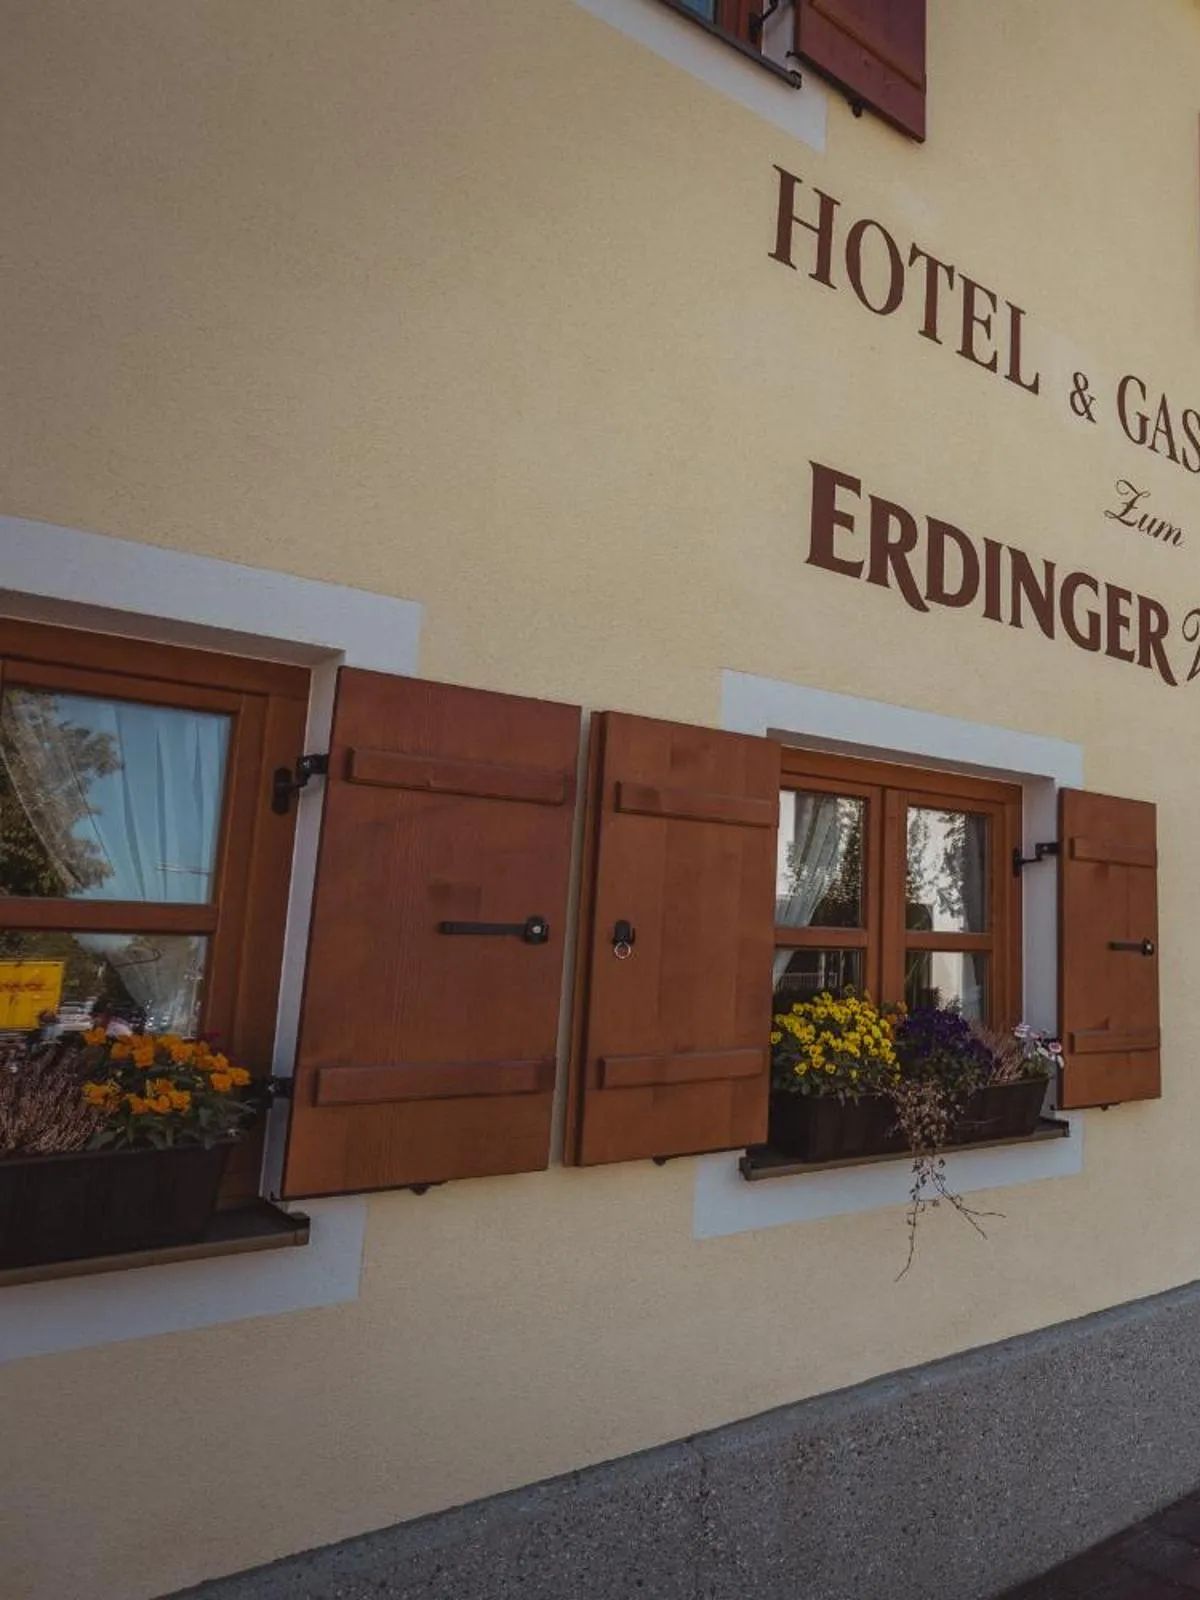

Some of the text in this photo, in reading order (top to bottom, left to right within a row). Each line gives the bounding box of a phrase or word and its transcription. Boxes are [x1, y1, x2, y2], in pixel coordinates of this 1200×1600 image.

[768, 164, 1040, 396] HOTEL
[1069, 371, 1097, 424] &
[803, 459, 1179, 688] ERDINGER
[1103, 479, 1186, 549] Zum
